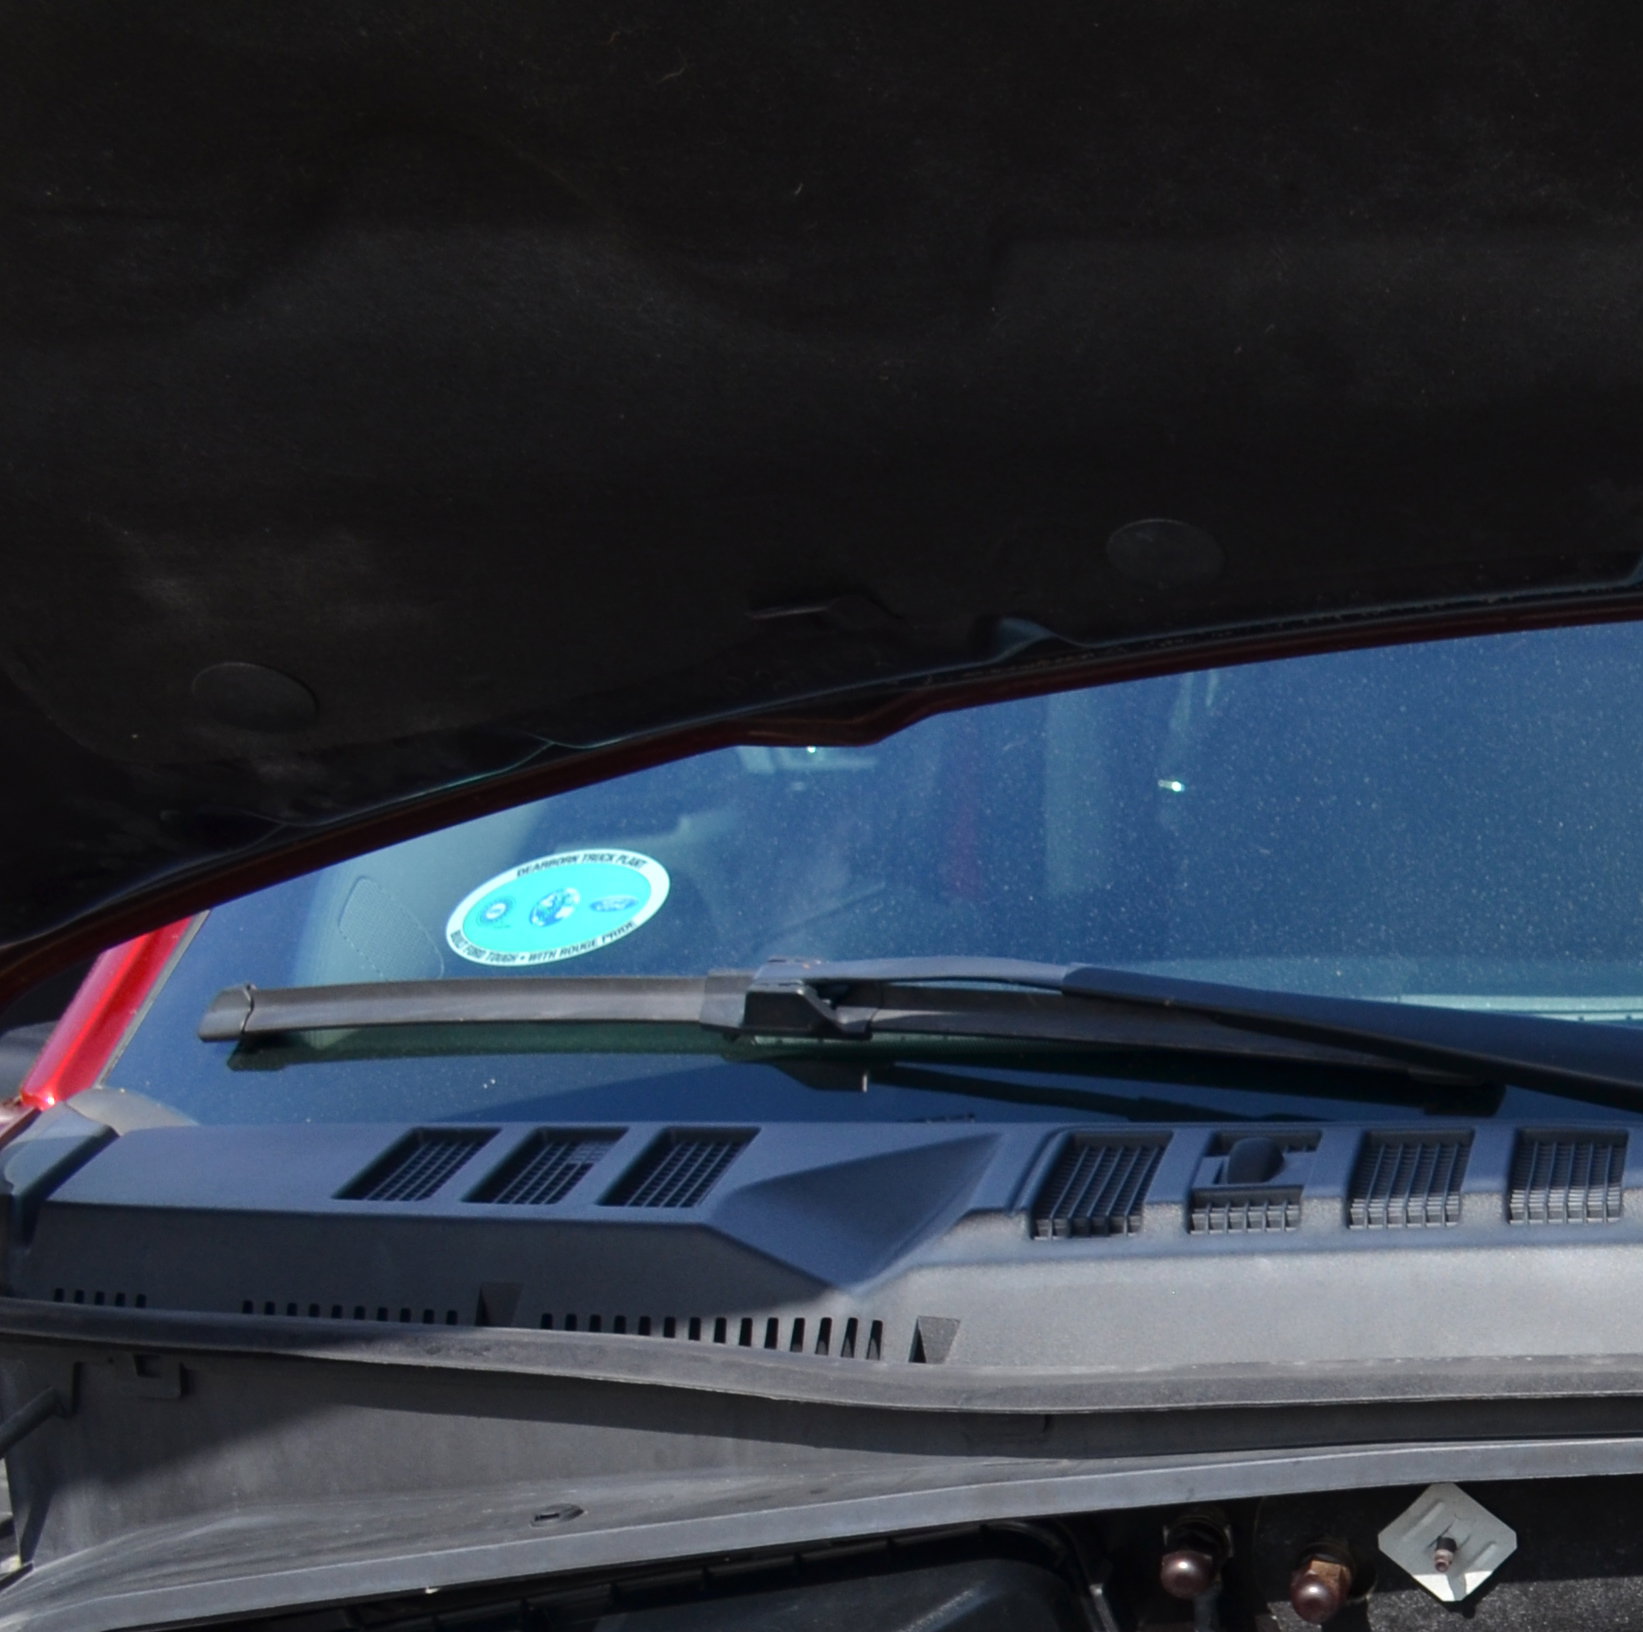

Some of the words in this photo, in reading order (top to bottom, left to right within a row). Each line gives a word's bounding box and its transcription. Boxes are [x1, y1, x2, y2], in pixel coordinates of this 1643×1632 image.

[580, 853, 615, 864] TRUCK
[487, 949, 518, 963] TOUGH
[528, 949, 558, 963] WITH
